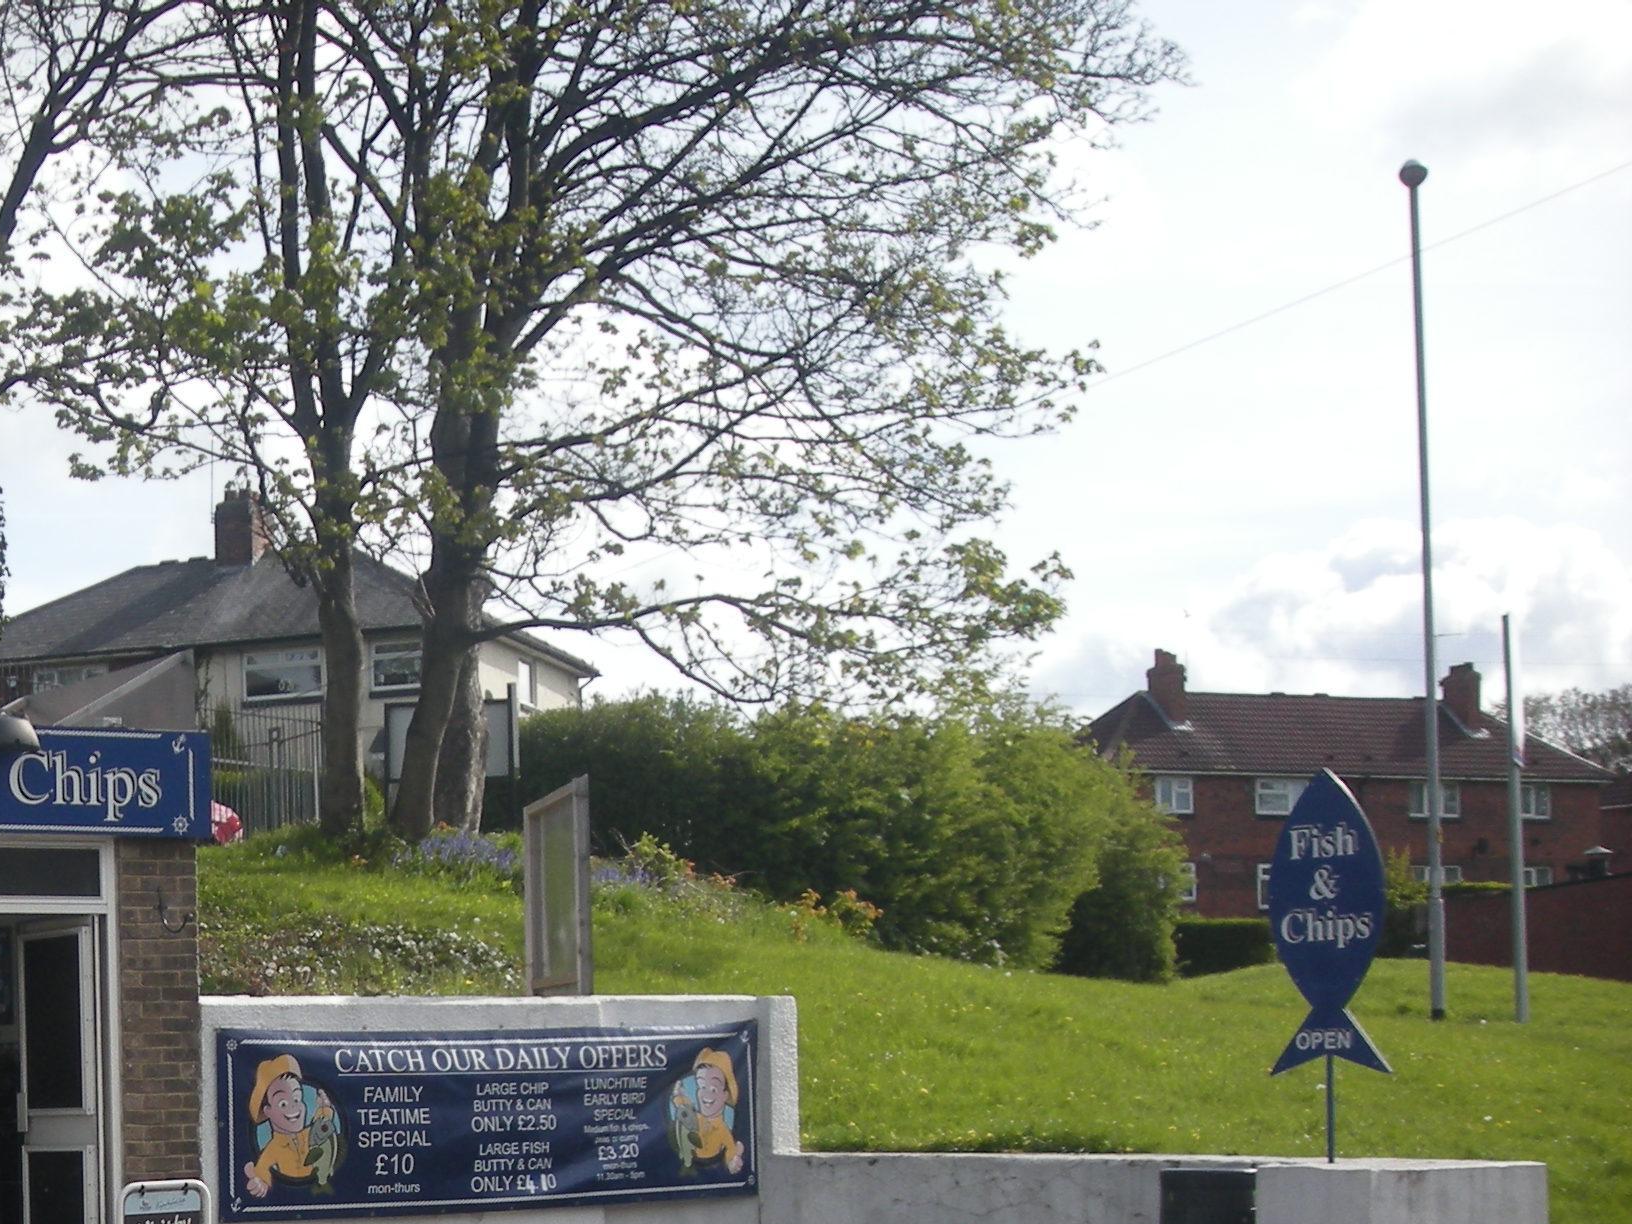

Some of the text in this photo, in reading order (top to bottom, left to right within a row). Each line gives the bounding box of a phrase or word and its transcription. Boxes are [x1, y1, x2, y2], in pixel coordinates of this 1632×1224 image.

[8, 748, 162, 823] Chips
[1288, 823, 1356, 901] Fish &
[1281, 908, 1374, 949] Chips
[1295, 1031, 1352, 1051] OPEN
[334, 1044, 668, 1073] CATCH OUR DAILY OFFERS
[476, 1081, 550, 1096] LARGE CHIP
[584, 1077, 648, 1090] LUNCHTIME
[364, 1086, 424, 1103] FAMILY
[583, 1092, 646, 1106] EARLY BIRD
[473, 1098, 552, 1112] BUTTY & CAN
[357, 1108, 432, 1126] TEATIME
[471, 1114, 557, 1132] ONLY £2.50
[593, 1108, 636, 1121] SPECIAL
[358, 1130, 432, 1149] SPECIAL
[479, 1141, 550, 1156] LARGE FISH
[598, 1143, 639, 1161] £3.20
[375, 1153, 415, 1175] £10
[474, 1158, 552, 1172] BUTTY & CAN
[368, 1182, 421, 1195] mon-thurs
[471, 1173, 557, 1194] ONLY £4.10
